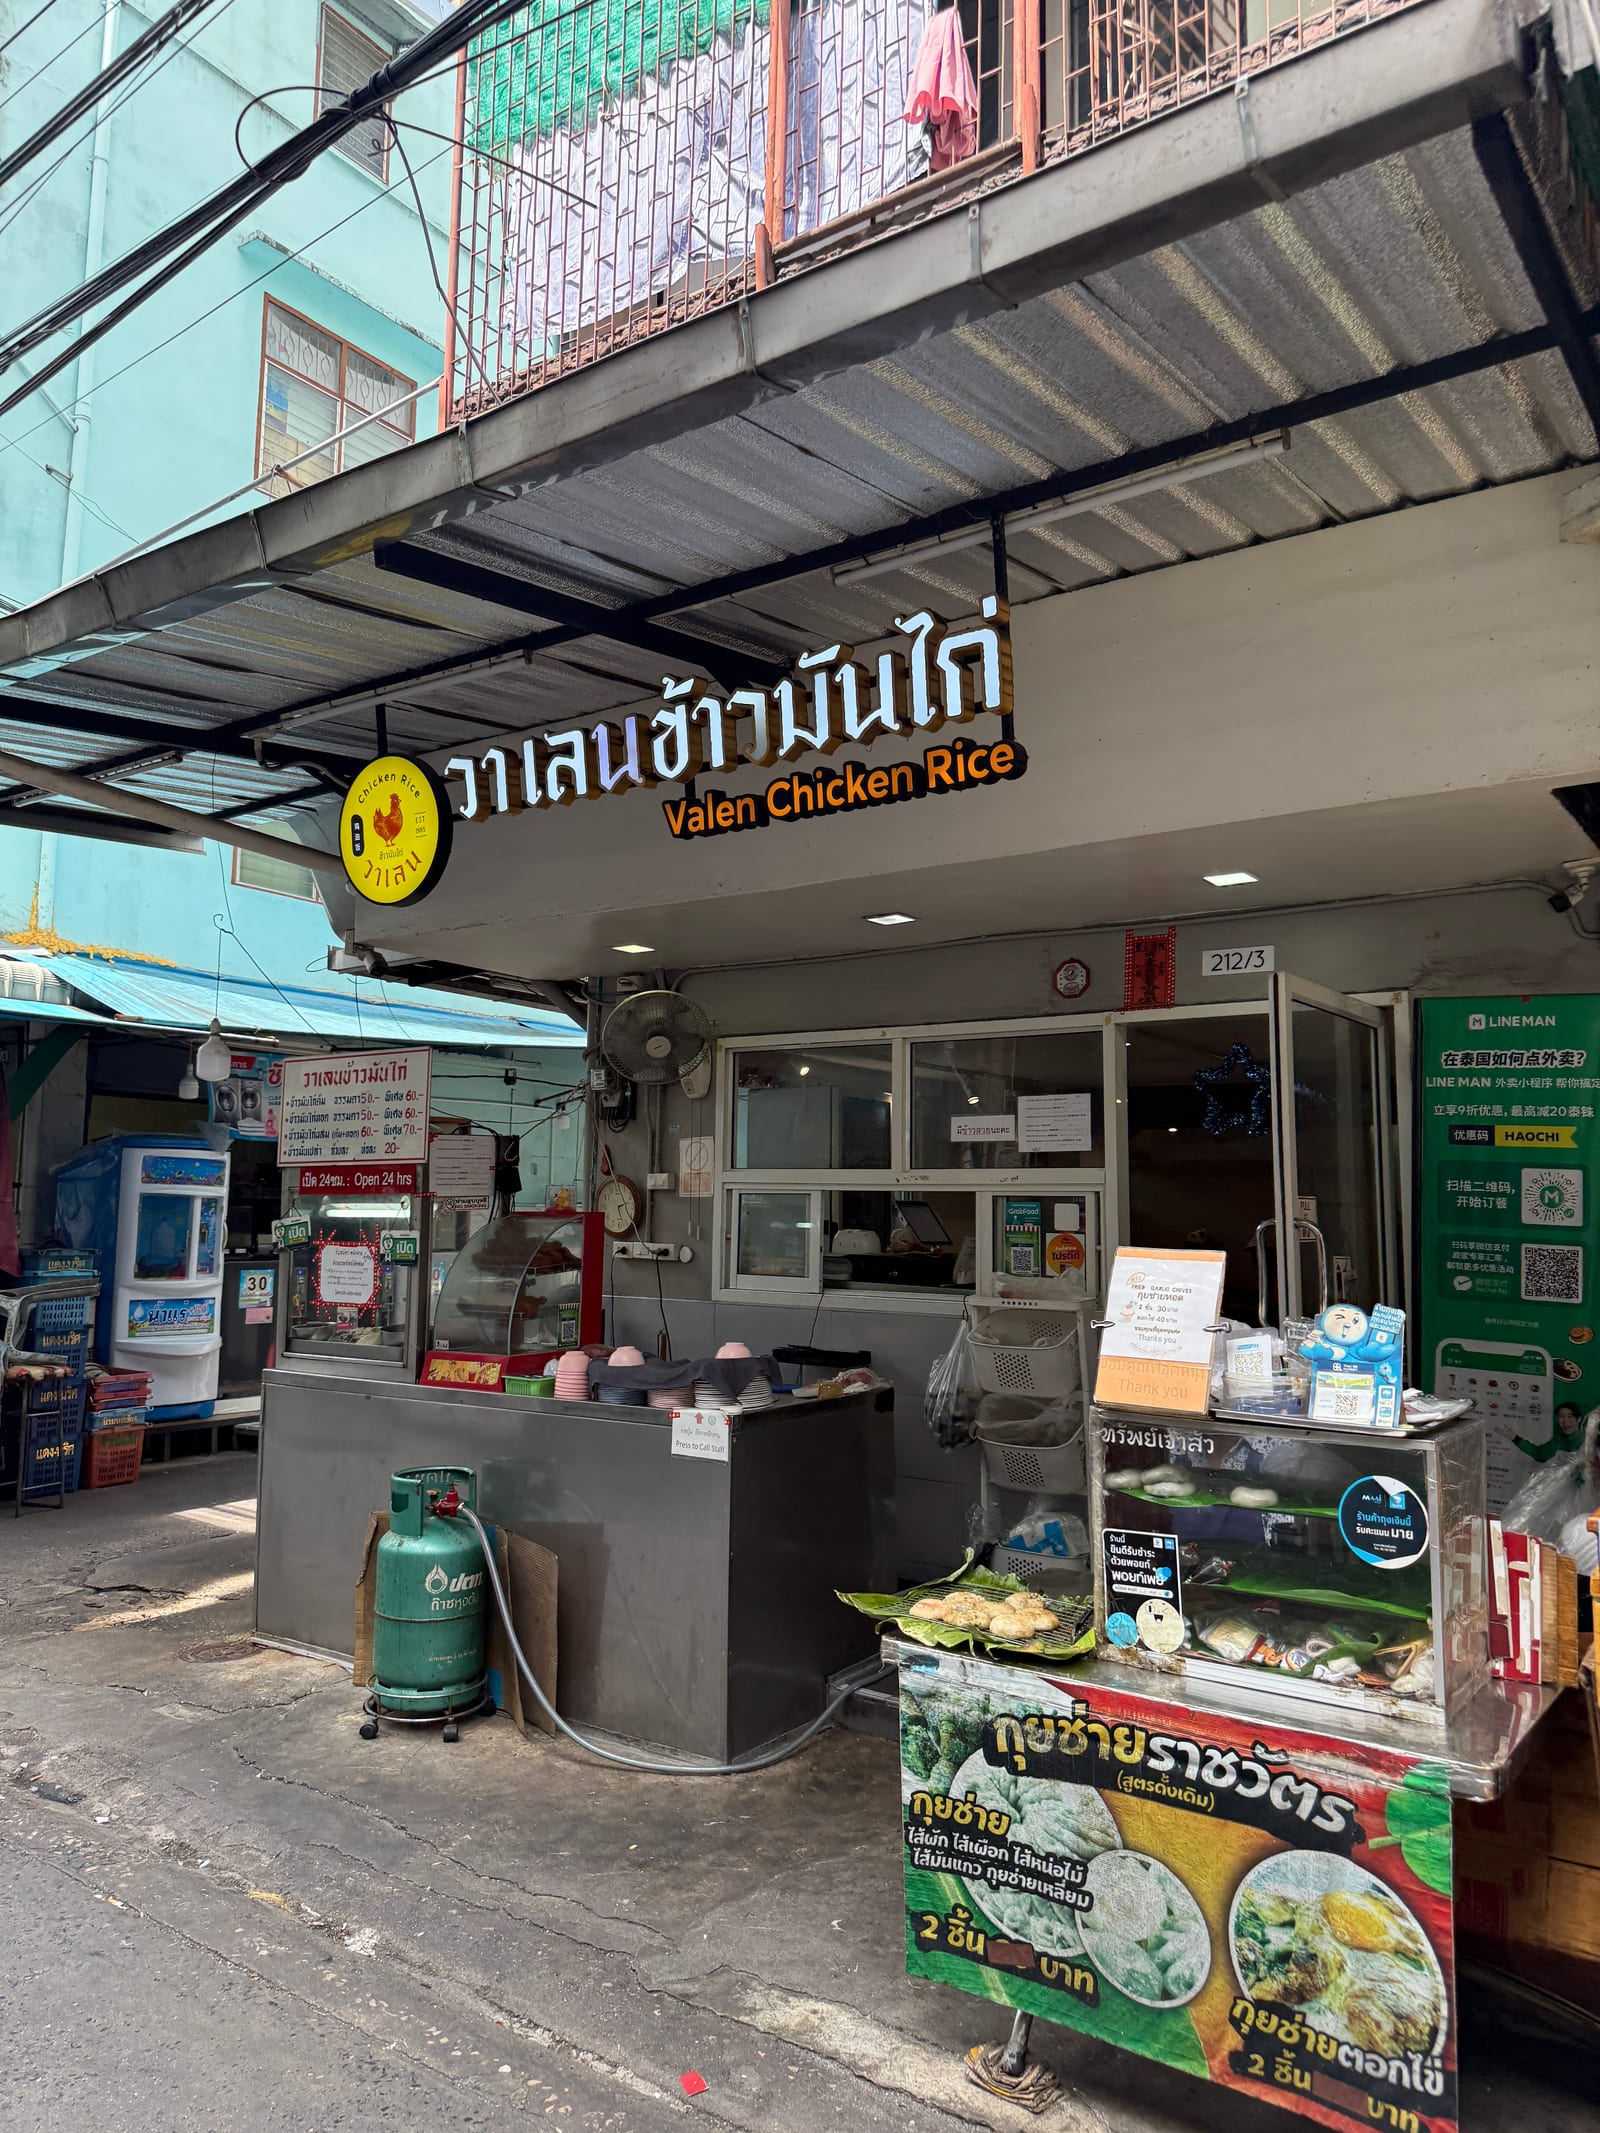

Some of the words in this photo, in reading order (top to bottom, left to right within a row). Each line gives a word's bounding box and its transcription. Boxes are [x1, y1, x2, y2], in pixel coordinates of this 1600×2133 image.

[444, 595, 1001, 818] วาเลนข้าวมันไก่
[358, 772, 396, 804] Chicken
[400, 774, 421, 799] Rice
[663, 792, 756, 836] Valen
[766, 763, 913, 818] Chicken
[926, 740, 1015, 788] Rice
[415, 815, 425, 824] EST
[364, 850, 423, 888] วาเลน
[1210, 950, 1265, 972] 212/3
[303, 1058, 408, 1088] วาเลนข้าวมันไก่
[1426, 1077, 1454, 1088] LINE
[1458, 1077, 1491, 1088] MAN
[1454, 1129, 1489, 1142] 优惠码
[1505, 1131, 1559, 1142] HAOCHI
[302, 1170, 317, 1187] เปิด
[354, 1172, 380, 1189] Open
[382, 1172, 394, 1187] 24
[396, 1171, 412, 1186] hrs
[1008, 1207, 1040, 1215] GrabFood
[288, 1224, 306, 1239] เปิด
[396, 1240, 414, 1254] เปิด
[247, 1276, 267, 1291] 30
[1138, 1334, 1162, 1342] Thanks
[1163, 1336, 1177, 1344] you
[1117, 1378, 1160, 1395] Thank
[1163, 1384, 1188, 1399] you
[675, 1440, 691, 1449] Press
[700, 1443, 710, 1451] Call
[711, 1444, 725, 1453] Staff
[1109, 1533, 1126, 1543] ร้านนี้
[1355, 1523, 1390, 1537] รับคะแนน
[1391, 1527, 1414, 1540] มาย
[1110, 1544, 1156, 1558] ยินดีรับชำระ
[1110, 1556, 1151, 1570] ด้วยพอยท์
[994, 1701, 1354, 1833] กุยช่ายราชวัตร
[1116, 1771, 1215, 1813] (สูตรดั้งเดิม)
[912, 1791, 1010, 1836] กุยช่าย
[907, 1825, 949, 1848] ไส้ผัก
[952, 1832, 1009, 1861] ไส้เผือก
[1013, 1845, 1084, 1883] ไส้หน่อไม้
[913, 1847, 982, 1876] ไส้มันแกว
[986, 1865, 1090, 1908] กุยช่ายเหลี่ยม
[919, 1914, 939, 1940] 2
[947, 1907, 985, 1956] ชิ้น
[1040, 1955, 1095, 1994] บาท
[1232, 1998, 1444, 2096] กุยช่ายตอกไข่
[1247, 2053, 1265, 2077] 2
[1273, 2049, 1312, 2091] ชิ้น
[1367, 2096, 1420, 2133] บาท
